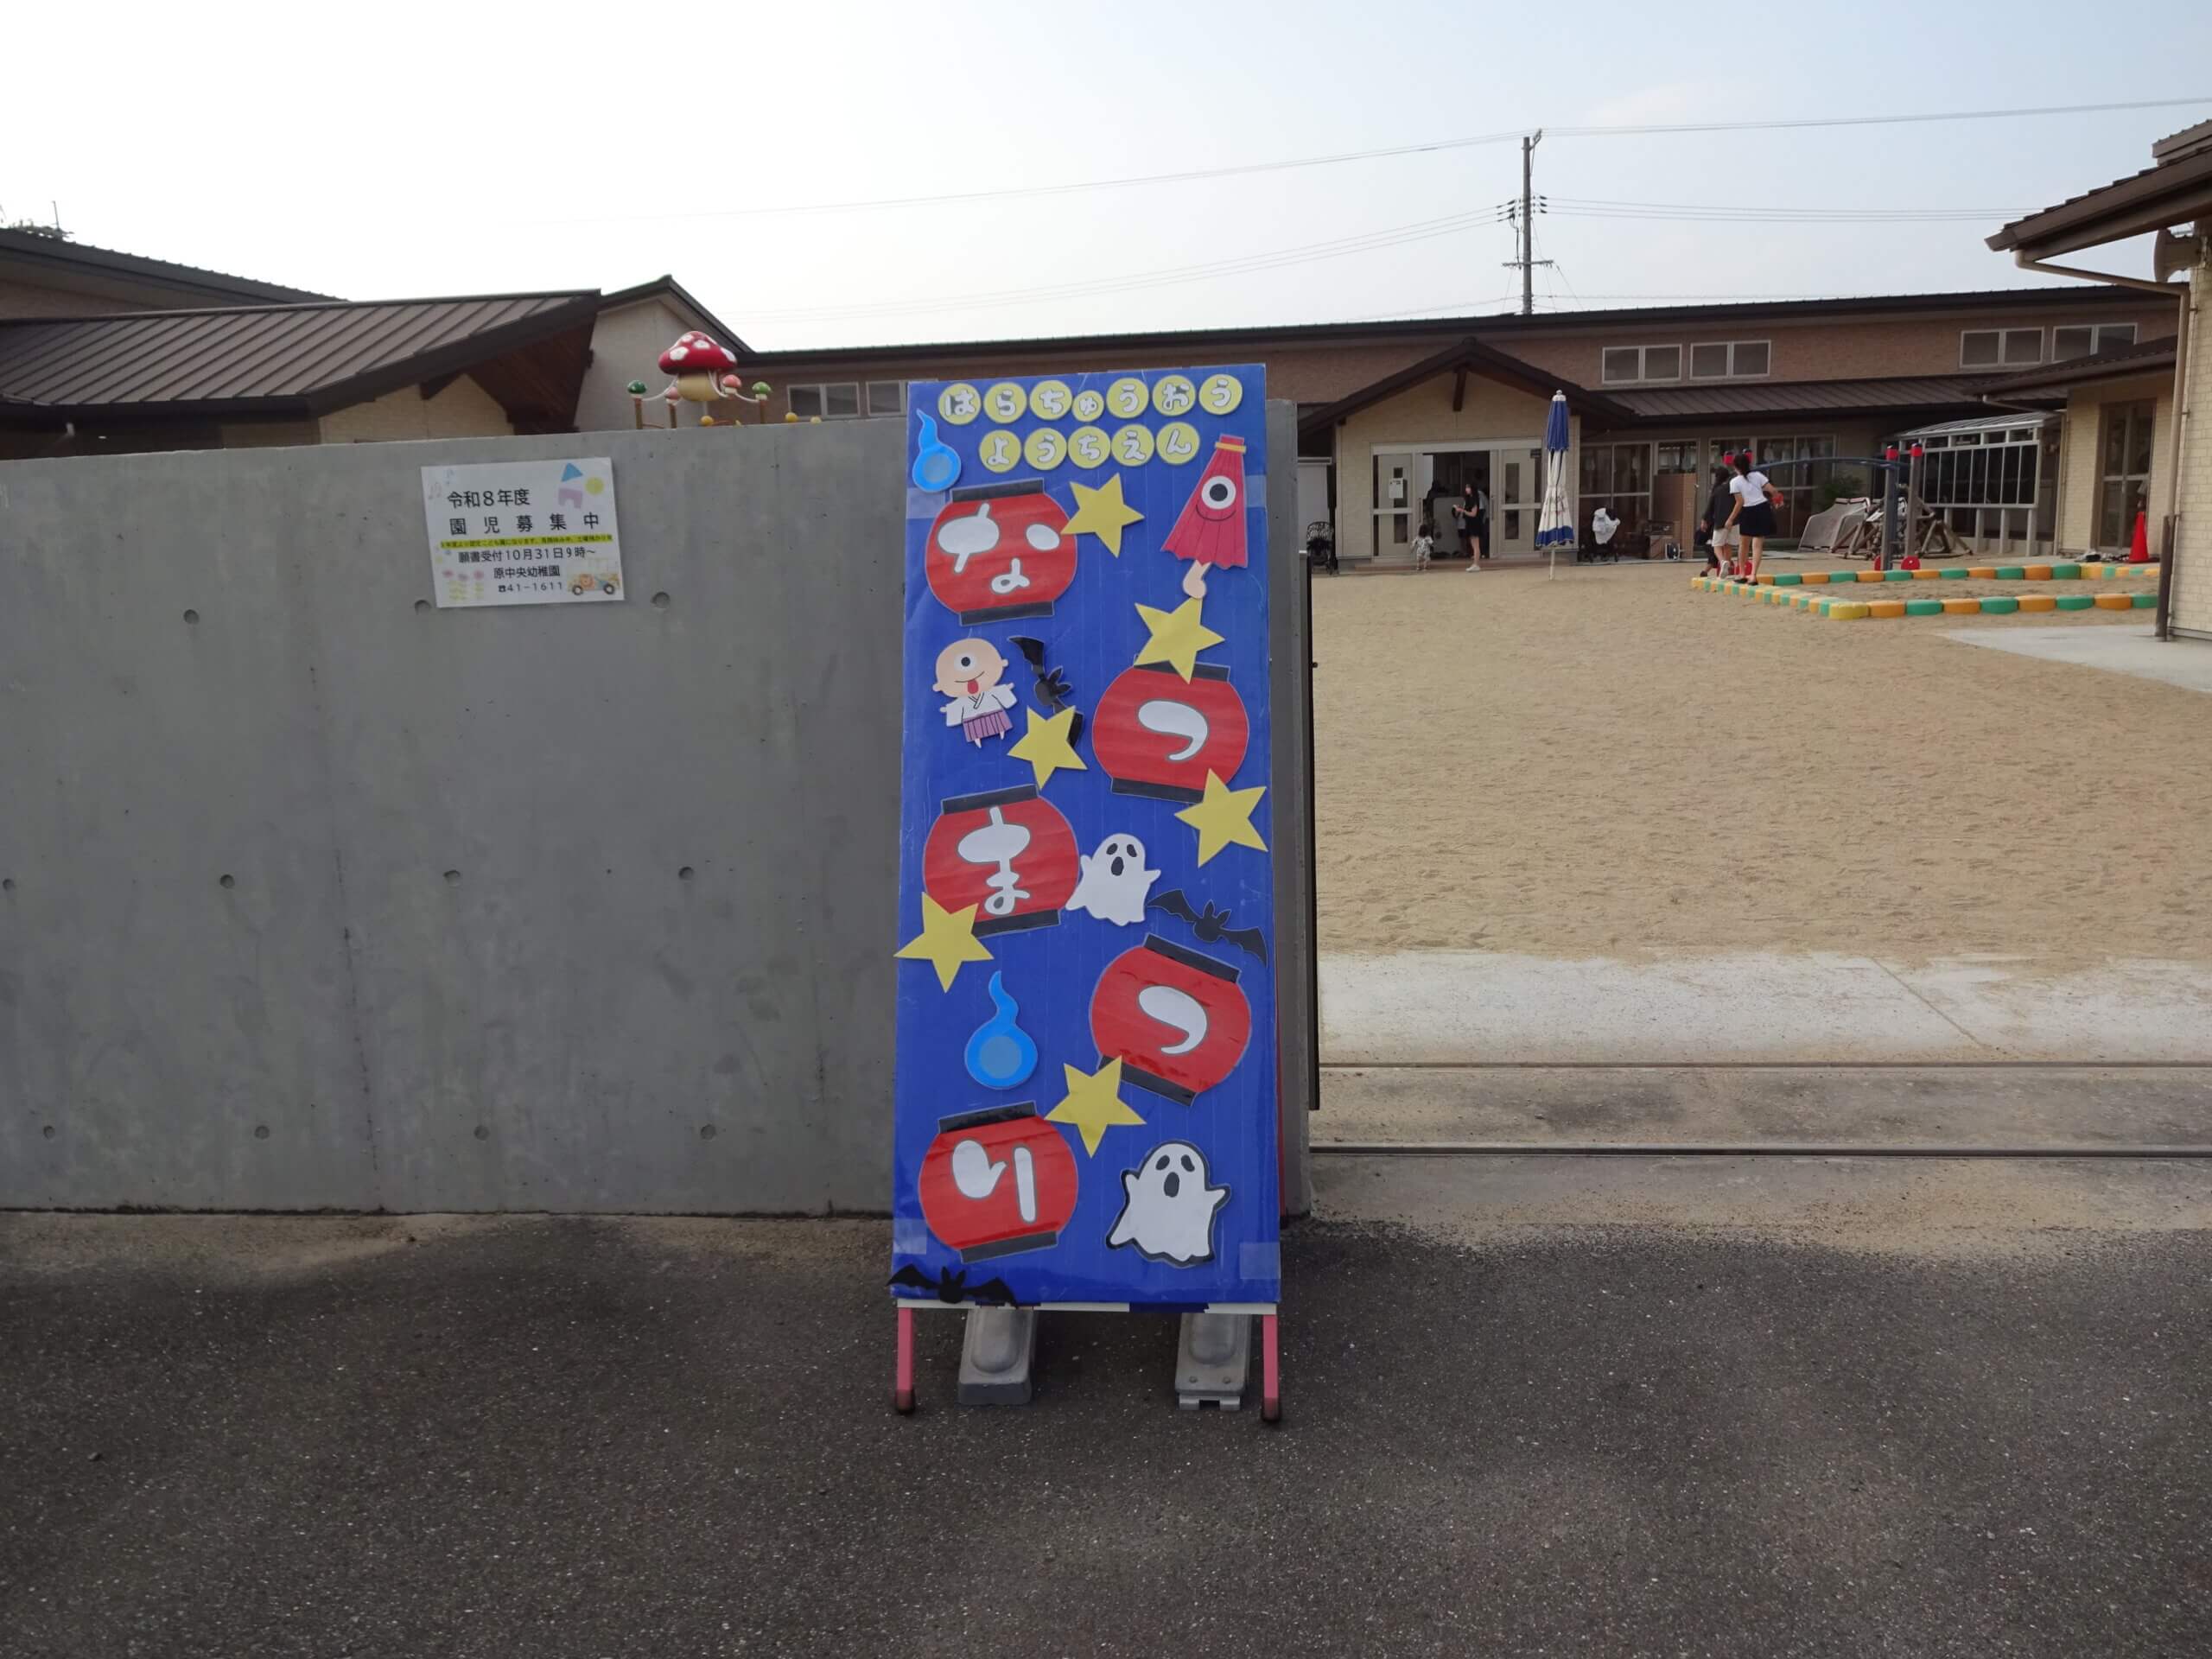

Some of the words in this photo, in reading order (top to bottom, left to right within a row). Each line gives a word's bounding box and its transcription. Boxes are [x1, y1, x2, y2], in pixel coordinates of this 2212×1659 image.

[944, 378, 1232, 417] はらちゅうおう
[987, 429, 1192, 467] ようちえん
[448, 488, 531, 509] 令和8年度
[449, 512, 599, 536] 園児募集中
[493, 565, 561, 580] 原中央幼稚園
